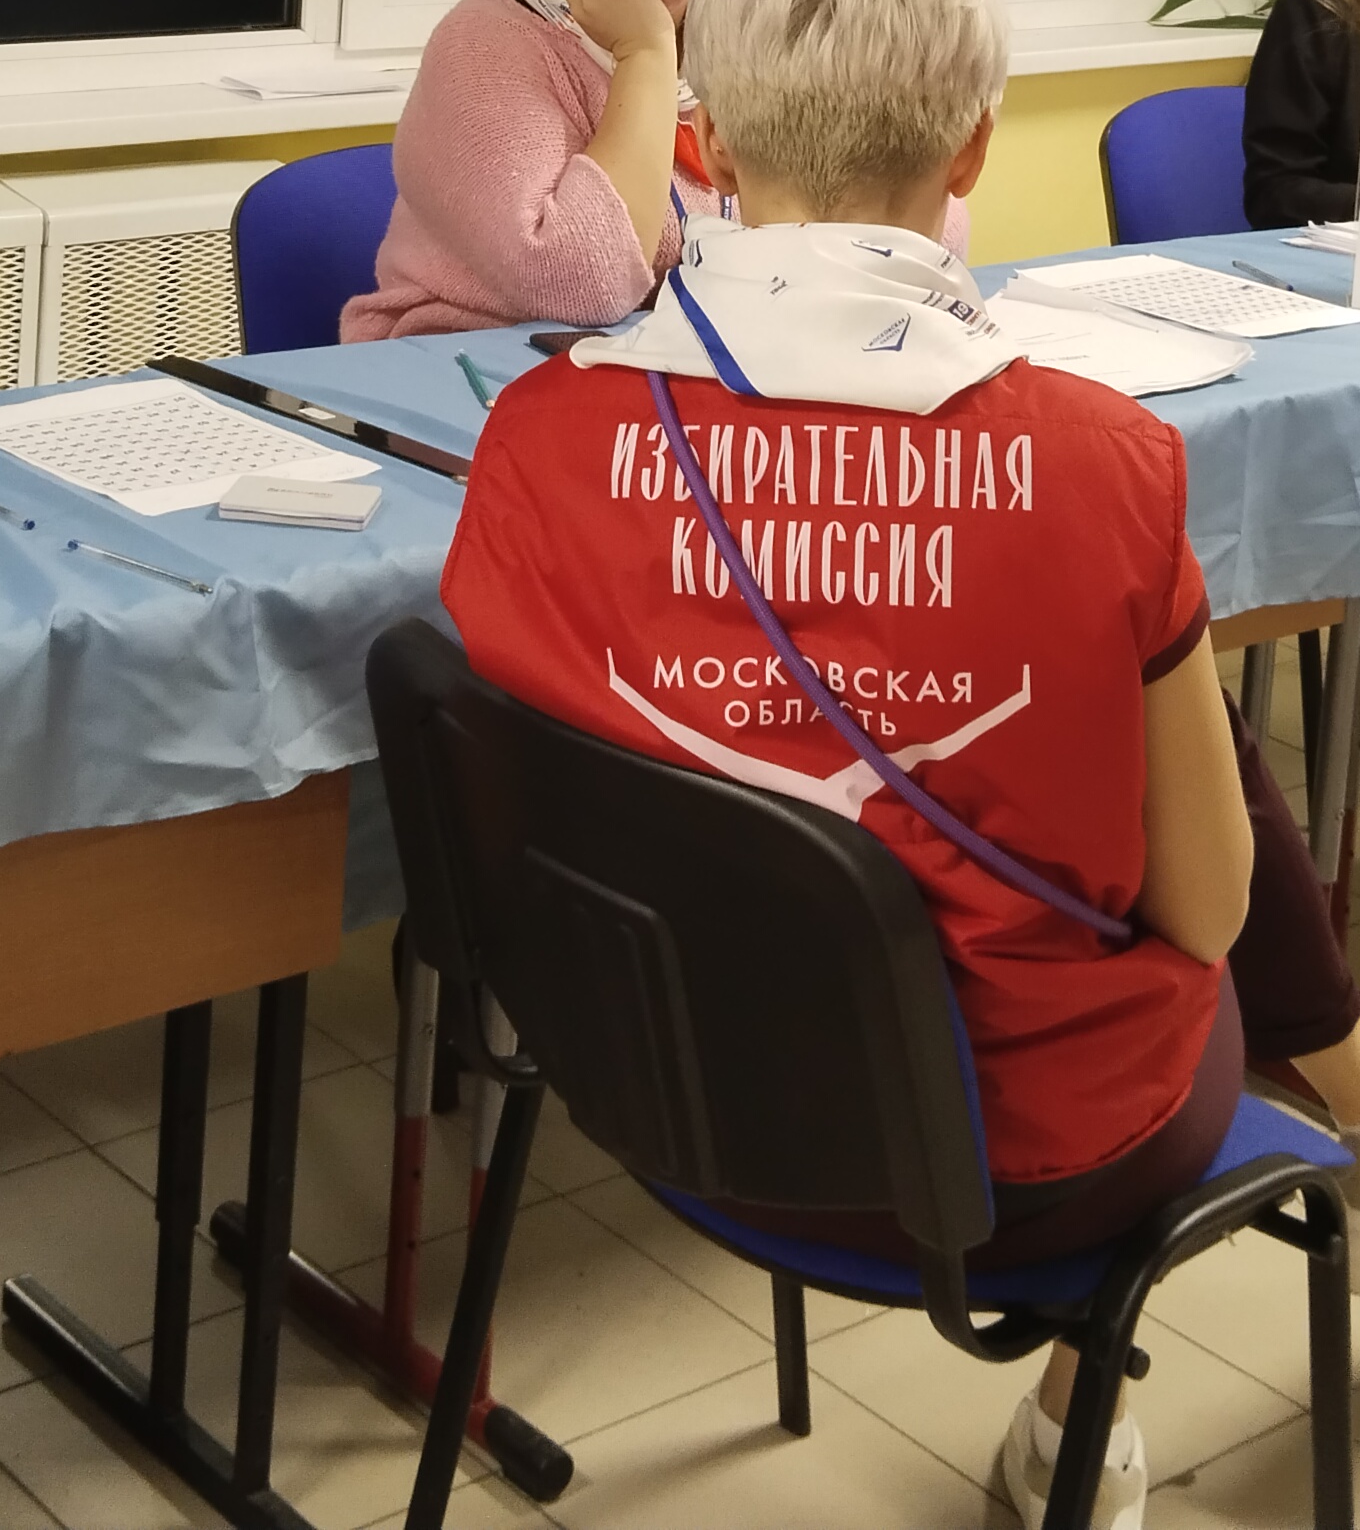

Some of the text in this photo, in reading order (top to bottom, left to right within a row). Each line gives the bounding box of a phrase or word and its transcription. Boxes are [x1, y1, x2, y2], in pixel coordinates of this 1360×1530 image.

[611, 422, 1033, 511] ИЗБИРАТЕЛЬНАЯ
[671, 516, 953, 608] КОМИССИЯ
[724, 698, 897, 736] ОБЛТЬ
